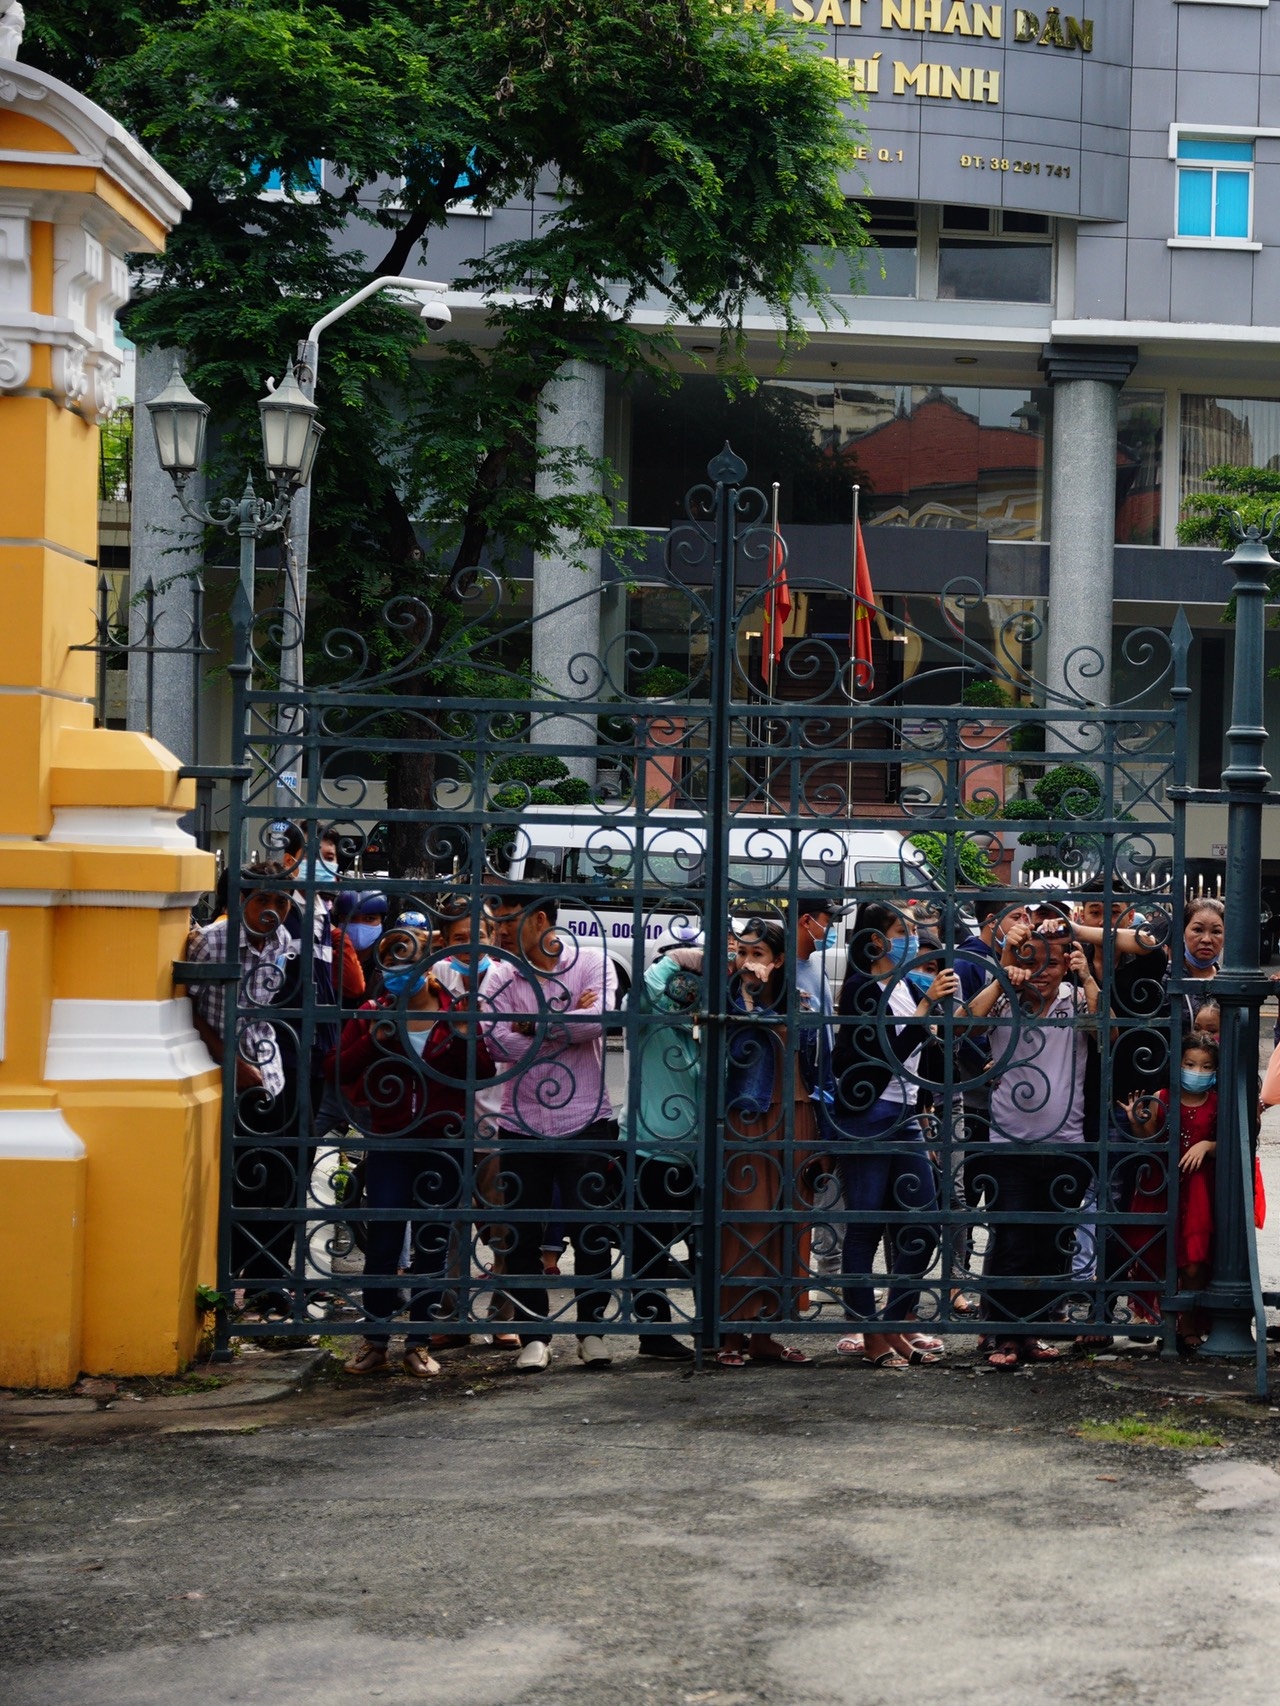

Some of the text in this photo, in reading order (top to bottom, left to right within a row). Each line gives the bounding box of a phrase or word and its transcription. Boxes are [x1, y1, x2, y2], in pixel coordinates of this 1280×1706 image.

[1014, 7, 1094, 52] DÂN
[822, 52, 1000, 104] HÍ MINH
[990, 157, 1010, 171] 38
[568, 921, 599, 937] 50A
